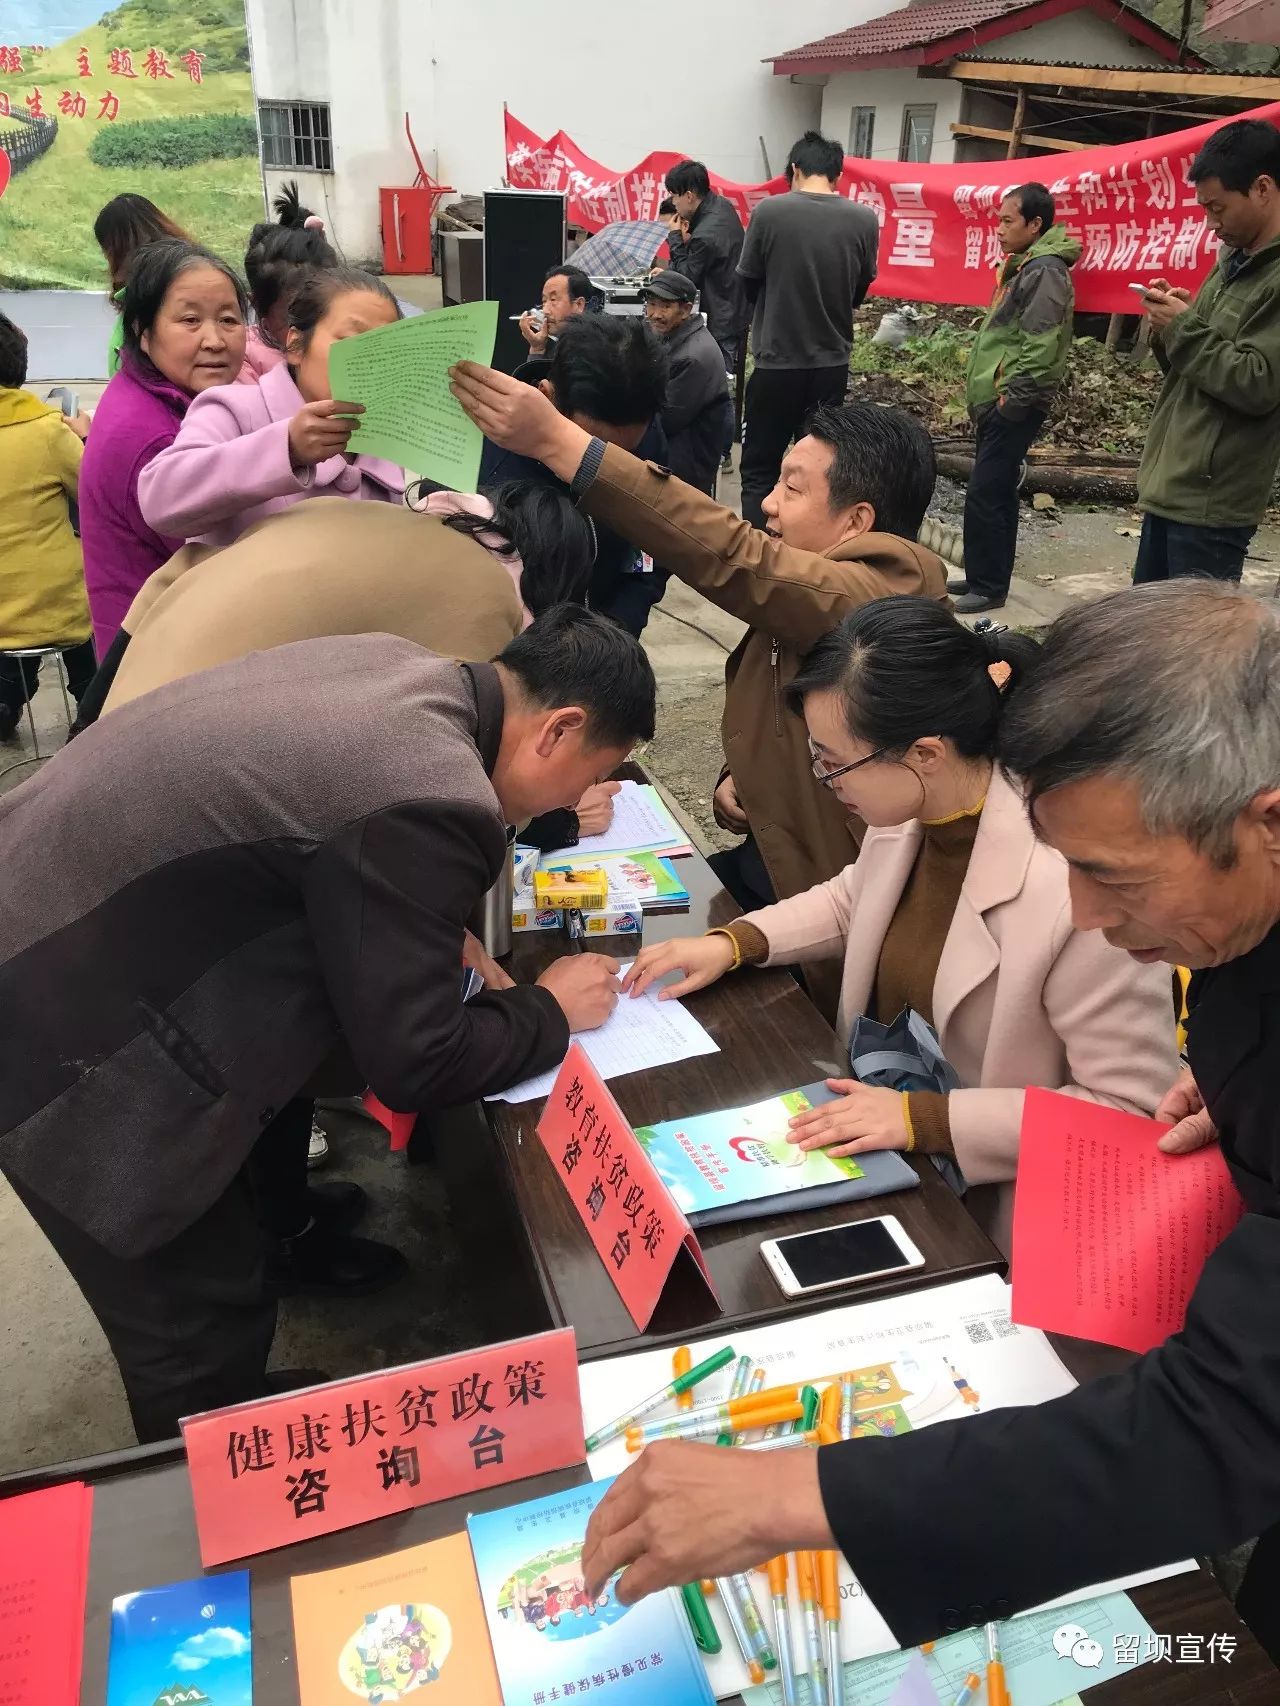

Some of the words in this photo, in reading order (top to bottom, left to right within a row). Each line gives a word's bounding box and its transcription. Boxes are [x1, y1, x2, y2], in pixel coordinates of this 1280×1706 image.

[76, 47, 206, 84] 主题教育
[561, 1133, 631, 1270] 咨询台
[565, 1076, 665, 1259] 教育扶贫政策
[226, 1360, 547, 1479] 健康扶贫政策
[285, 1424, 507, 1519] 咨询台
[532, 1651, 663, 1705] 常见慢性病保健手册
